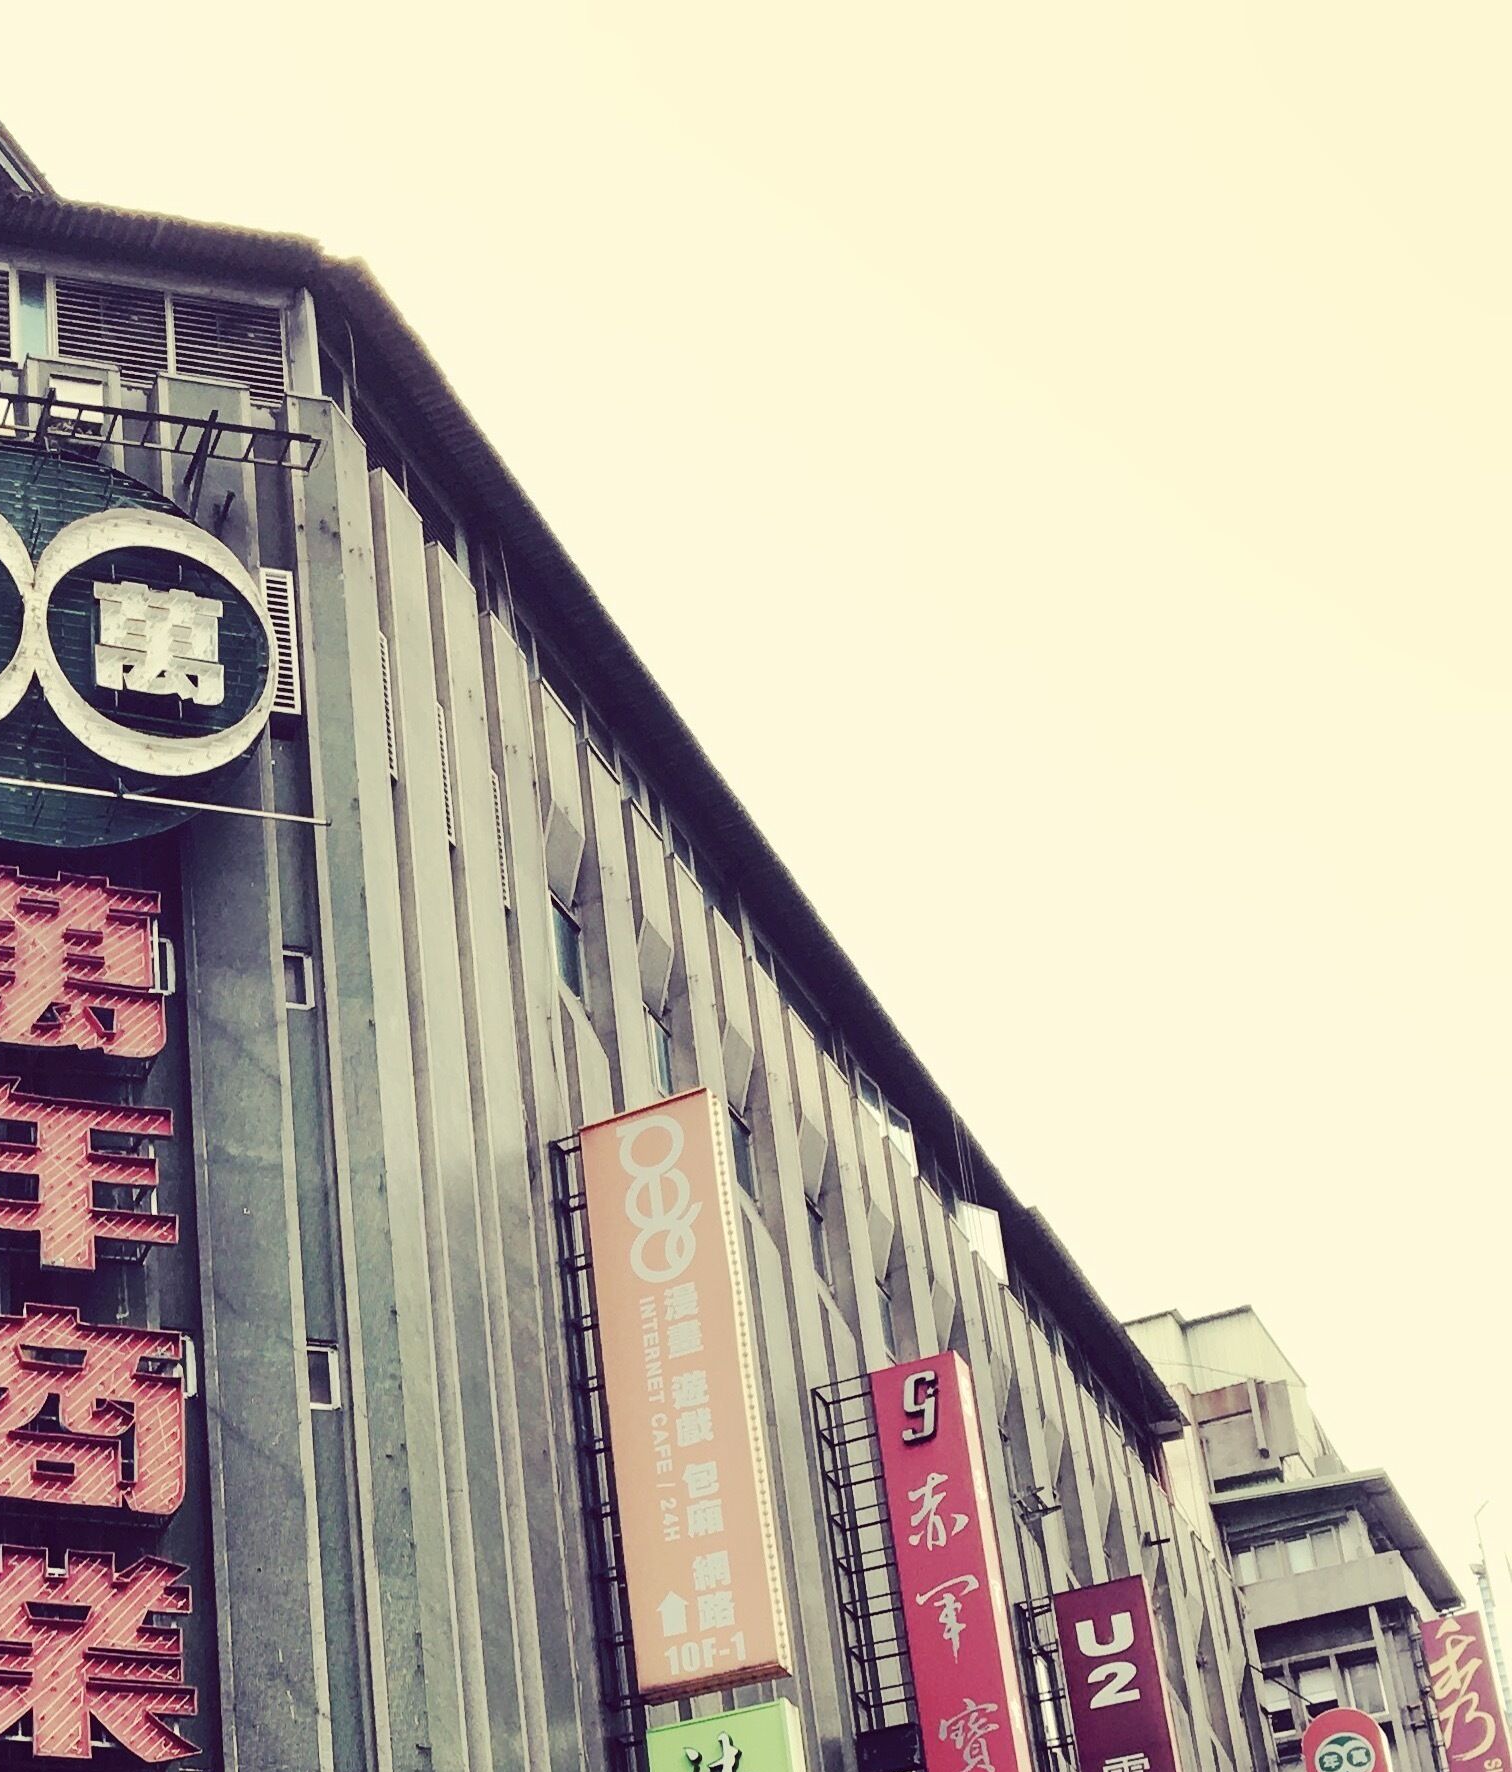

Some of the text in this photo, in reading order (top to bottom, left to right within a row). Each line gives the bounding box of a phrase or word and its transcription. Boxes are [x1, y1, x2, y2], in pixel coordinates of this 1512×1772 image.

[640, 1297, 666, 1405] INTERNET
[649, 1412, 670, 1475] CAFE
[660, 1498, 680, 1543] 24H
[691, 1550, 735, 1631] 網路
[664, 1633, 747, 1676] 10F-1
